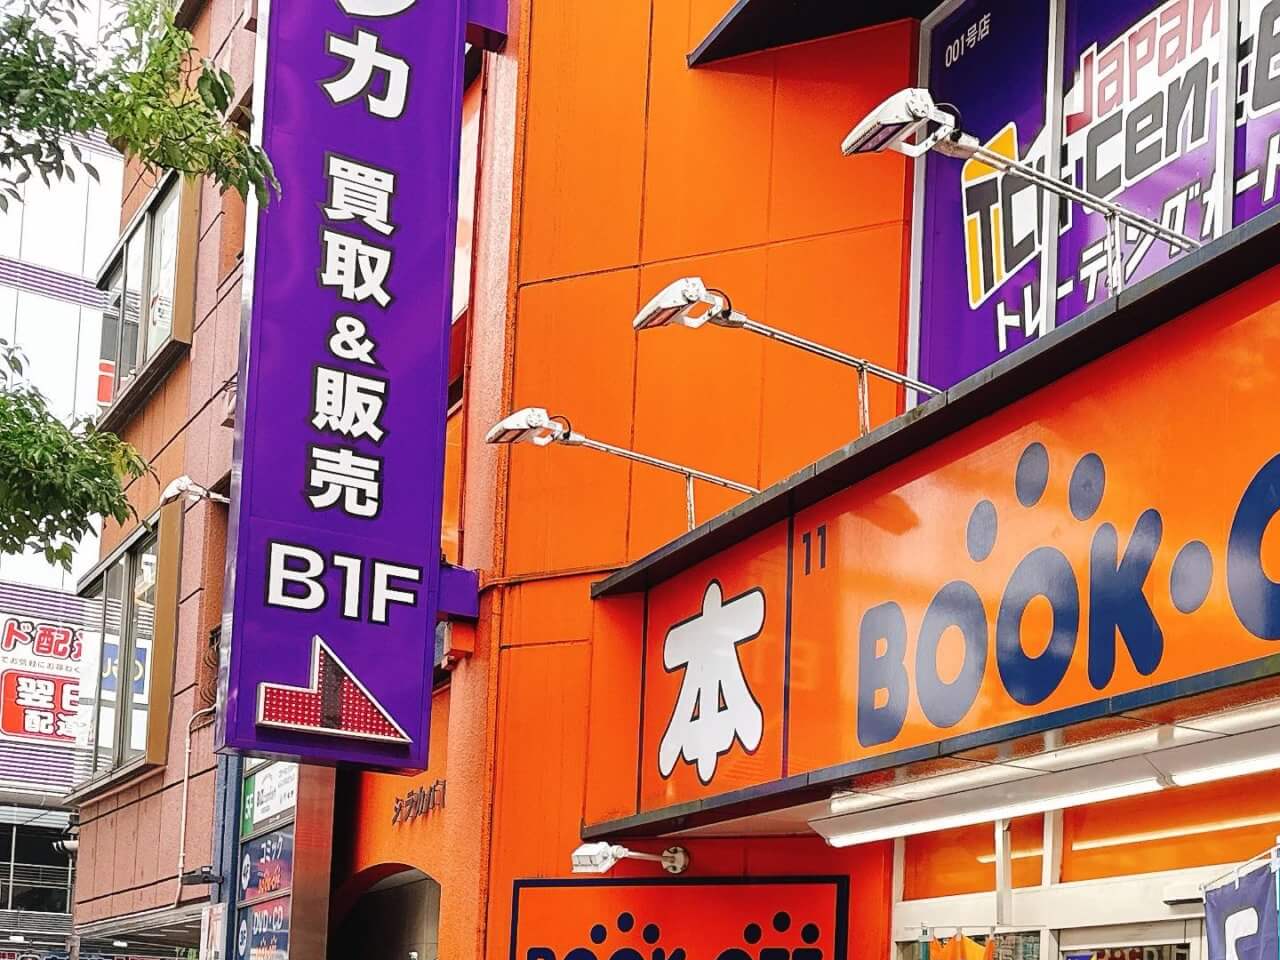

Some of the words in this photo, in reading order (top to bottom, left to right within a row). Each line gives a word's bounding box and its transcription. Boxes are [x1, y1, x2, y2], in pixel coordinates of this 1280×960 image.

[322, 0, 411, 120] カ
[944, 13, 992, 69] 001号店
[267, 542, 421, 624] B1F
[801, 524, 829, 577] 11
[659, 578, 765, 784] 本
